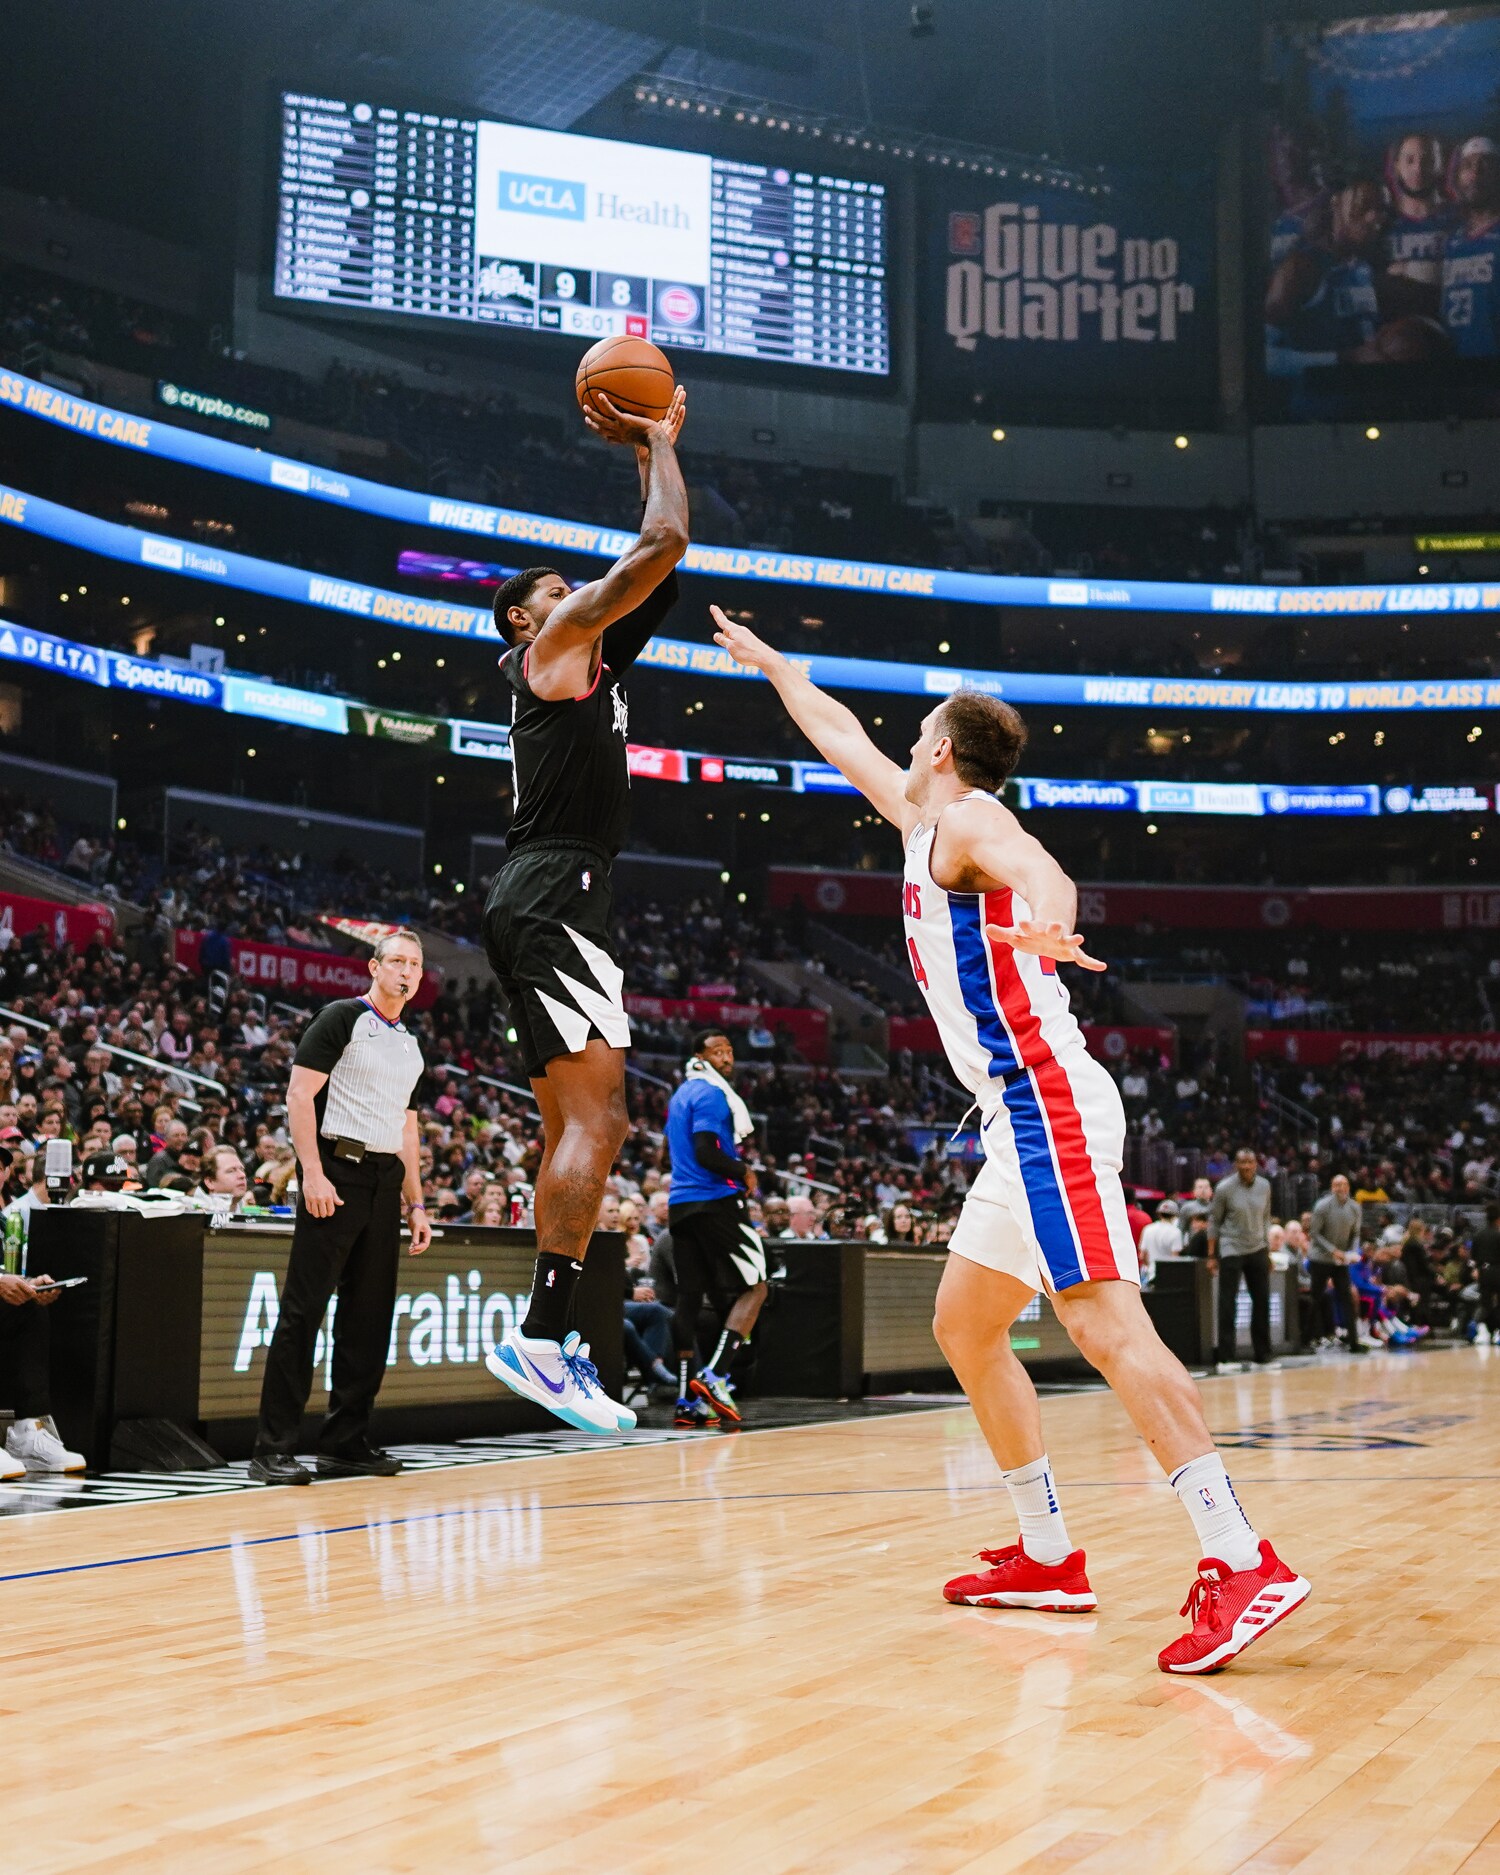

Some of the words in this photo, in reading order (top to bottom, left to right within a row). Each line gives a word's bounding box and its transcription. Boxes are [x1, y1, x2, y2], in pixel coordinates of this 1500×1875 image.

[508, 180, 576, 212] UCLA
[595, 191, 690, 231] Health
[984, 203, 1117, 281] Give
[1123, 238, 1178, 281] no
[556, 271, 576, 299] 9
[611, 279, 631, 306] 8
[946, 261, 1194, 350] Quarter
[572, 312, 614, 333] 6:01
[25, 386, 96, 431] HEALTH
[97, 413, 152, 448] CARE
[181, 391, 270, 429] crypto.com
[310, 475, 350, 499] Health
[428, 501, 497, 533] WHERE
[497, 515, 600, 550] DISCOVERY
[685, 548, 814, 582] WORLD-CLASS
[815, 562, 886, 589] HEALTH
[886, 570, 936, 594] CARE
[185, 552, 228, 576] Health
[308, 577, 373, 614] WHERE
[373, 594, 476, 633] DISCOVERY
[1089, 588, 1131, 604] Health
[1211, 588, 1277, 612] WHERE
[1278, 590, 1387, 613] DISCOVERY
[1386, 587, 1450, 612] LEADS
[1454, 587, 1480, 610] TO
[23, 636, 96, 675] DELTA
[115, 659, 210, 699] Spectrum
[1084, 680, 1150, 705] WHERE
[1152, 684, 1256, 707] DISCOVERY
[1255, 686, 1316, 710] LEADS
[1319, 686, 1345, 709] TO
[1349, 684, 1483, 708] WORLD-CLASS
[725, 764, 779, 782] TOYOTA
[1035, 783, 1125, 807] Spectrum
[1154, 790, 1190, 805] UCLA
[1290, 793, 1365, 810] crypto.com
